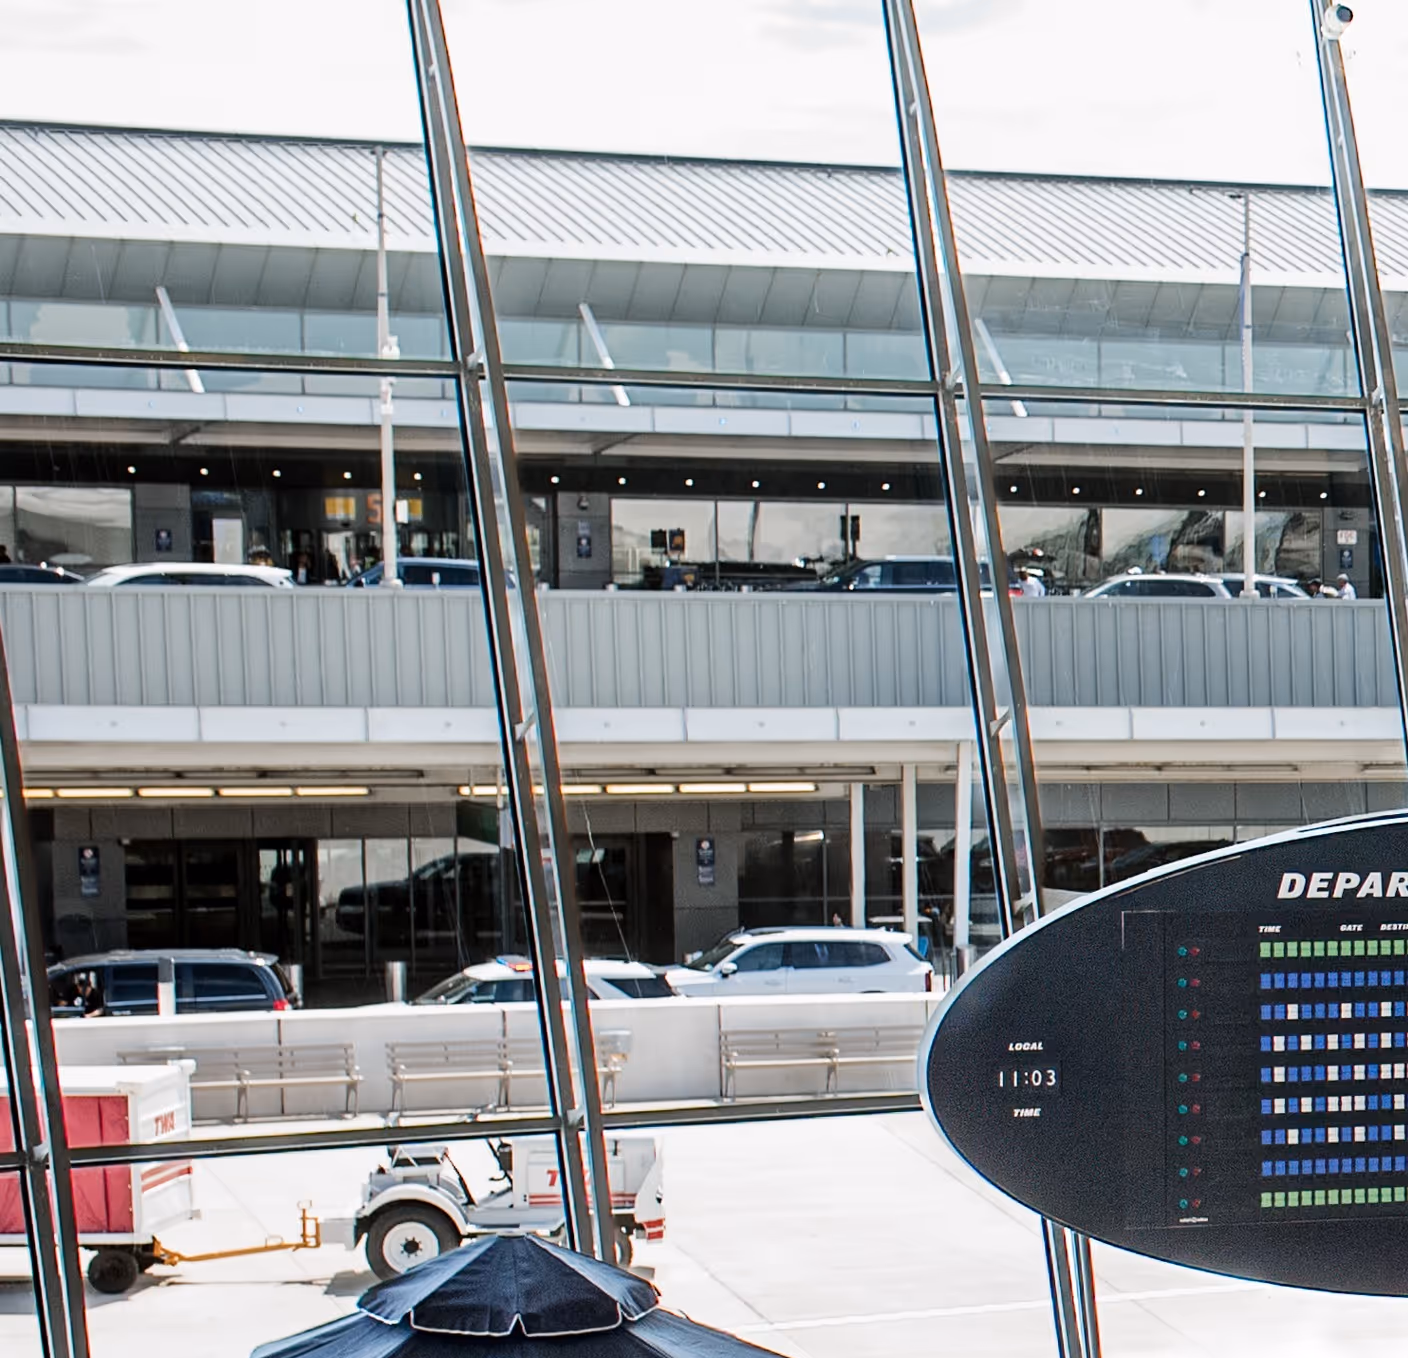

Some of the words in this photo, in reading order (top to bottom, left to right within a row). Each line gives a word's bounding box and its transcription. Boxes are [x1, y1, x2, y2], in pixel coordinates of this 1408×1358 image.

[1259, 925, 1281, 933] TIME
[1008, 1042, 1044, 1051] LOCAL
[999, 1070, 1056, 1087] 11:03
[1013, 1108, 1041, 1117] TIME
[154, 1110, 175, 1136] TWA
